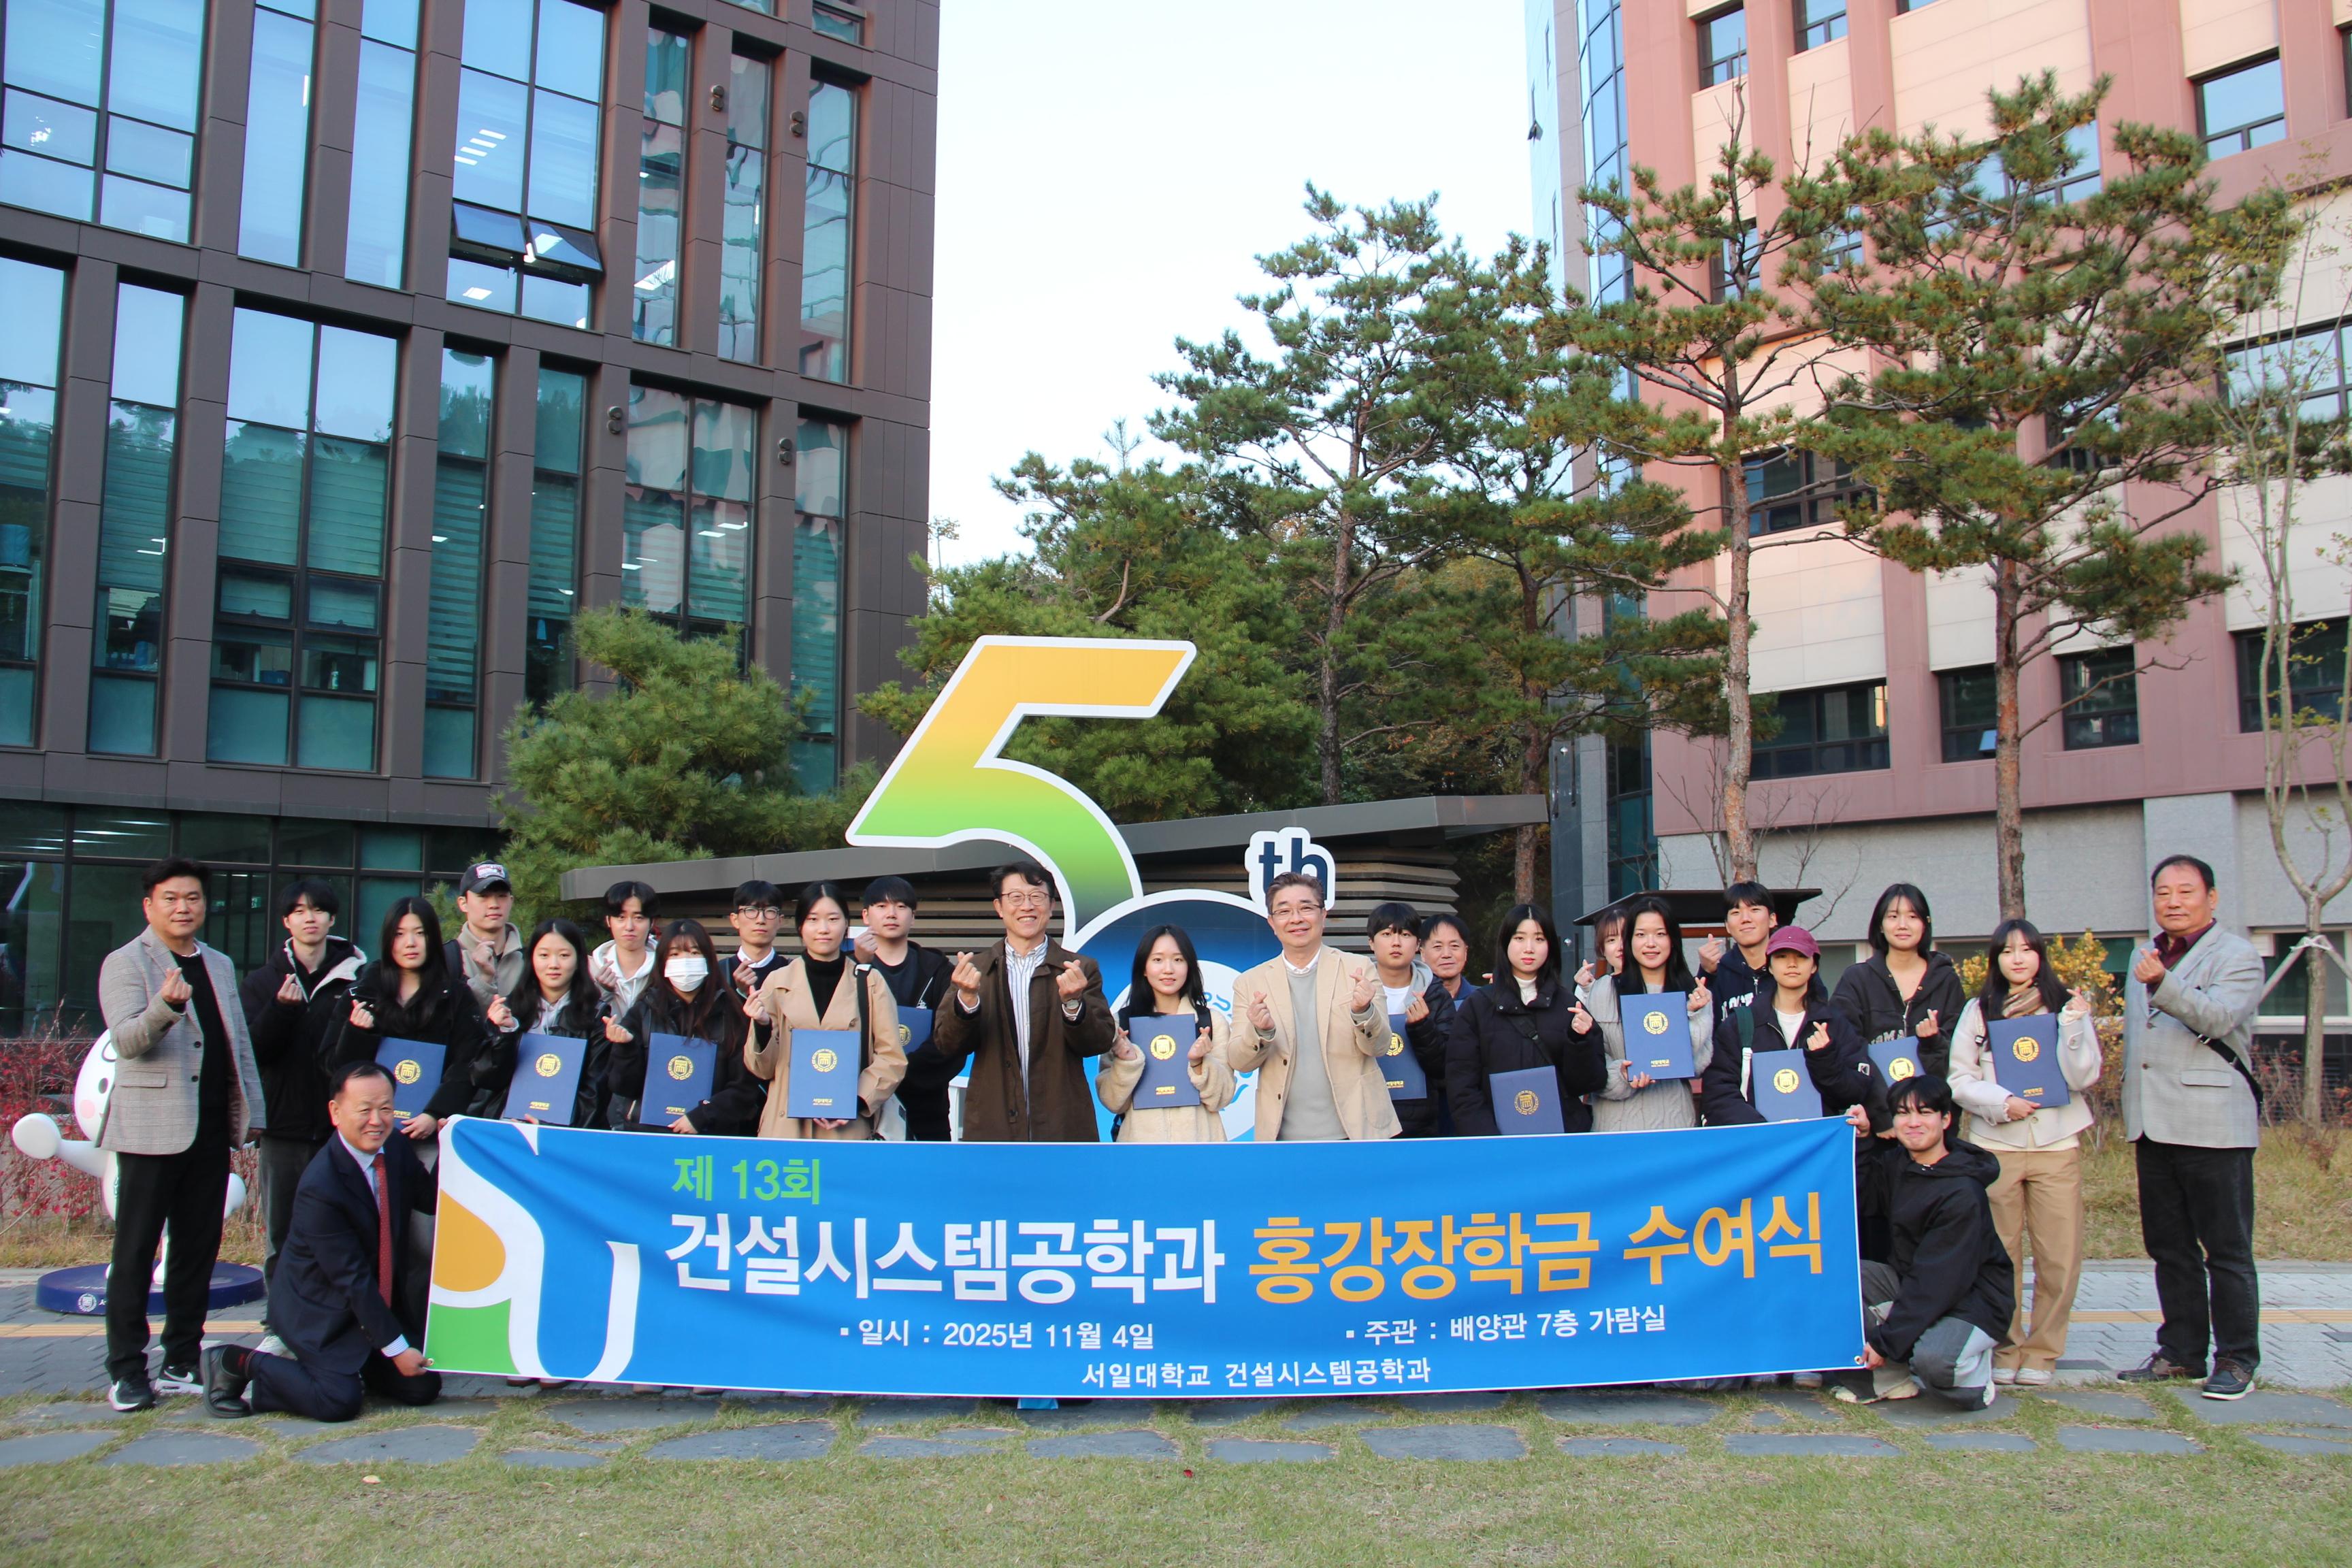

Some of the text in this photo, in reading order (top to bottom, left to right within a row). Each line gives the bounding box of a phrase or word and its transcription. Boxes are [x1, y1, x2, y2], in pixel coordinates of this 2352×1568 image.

[672, 1154, 821, 1205] 제 13회
[665, 1192, 1823, 1304] 건설시스템공학과 홍강장학금 수여식
[858, 1319, 909, 1347] 일시
[943, 1322, 1032, 1349] 2025년
[1045, 1322, 1102, 1350] 11월
[1112, 1323, 1154, 1350] 4일
[1364, 1319, 1418, 1346] 주관
[1450, 1313, 1528, 1341] 배양관
[1536, 1309, 1580, 1337] 7층
[1589, 1305, 1667, 1335] 가람실
[1081, 1358, 1432, 1388] 서일대학교 건설시스템공학과
